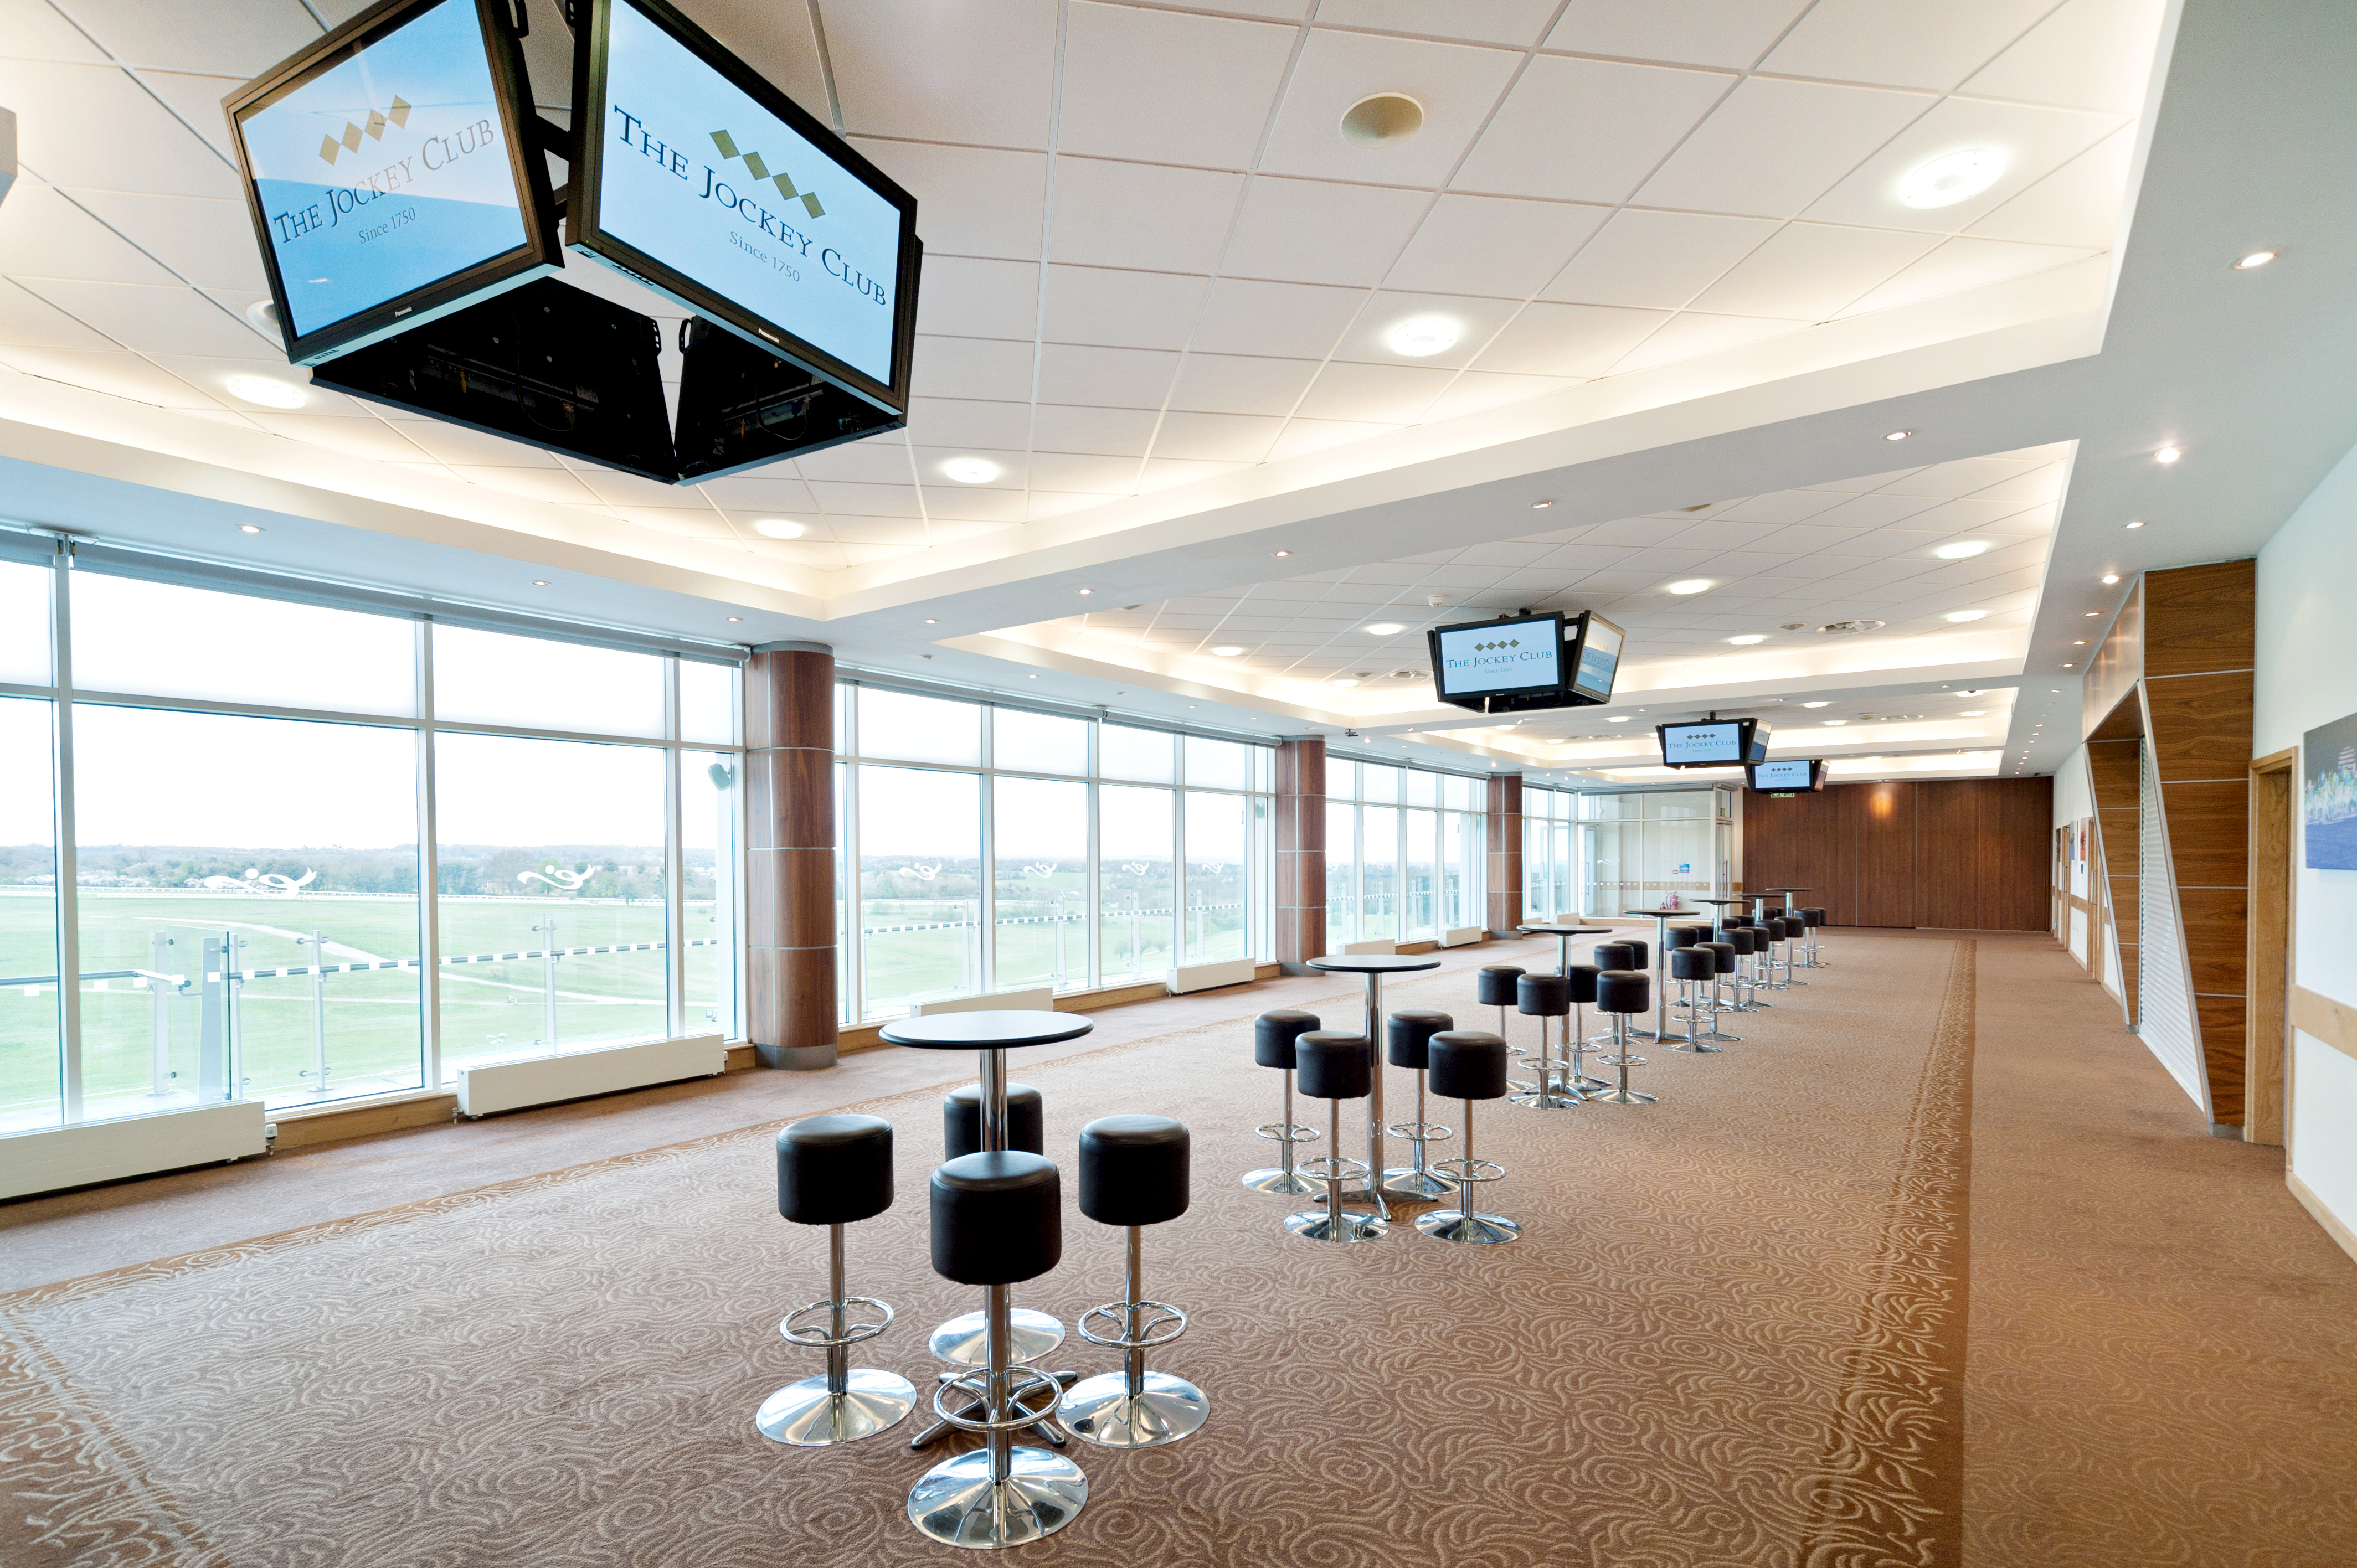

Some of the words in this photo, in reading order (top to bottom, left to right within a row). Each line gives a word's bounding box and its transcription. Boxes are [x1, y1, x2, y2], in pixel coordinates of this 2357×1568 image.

[274, 204, 323, 244] THE
[325, 156, 414, 228] JOCKEY
[421, 119, 495, 171] CLUB
[614, 104, 688, 180] THE
[698, 165, 813, 257] JOCKEY
[822, 248, 886, 306] CLUB
[358, 224, 389, 245] Since
[390, 207, 417, 229] 1750
[729, 231, 768, 263] Since
[772, 257, 800, 282] 1750
[395, 306, 413, 317] Panasonic
[758, 328, 780, 343] Panasonic
[1446, 659, 1469, 668] THE
[1473, 654, 1516, 668] JOCKEY
[1520, 651, 1552, 661] CLUB
